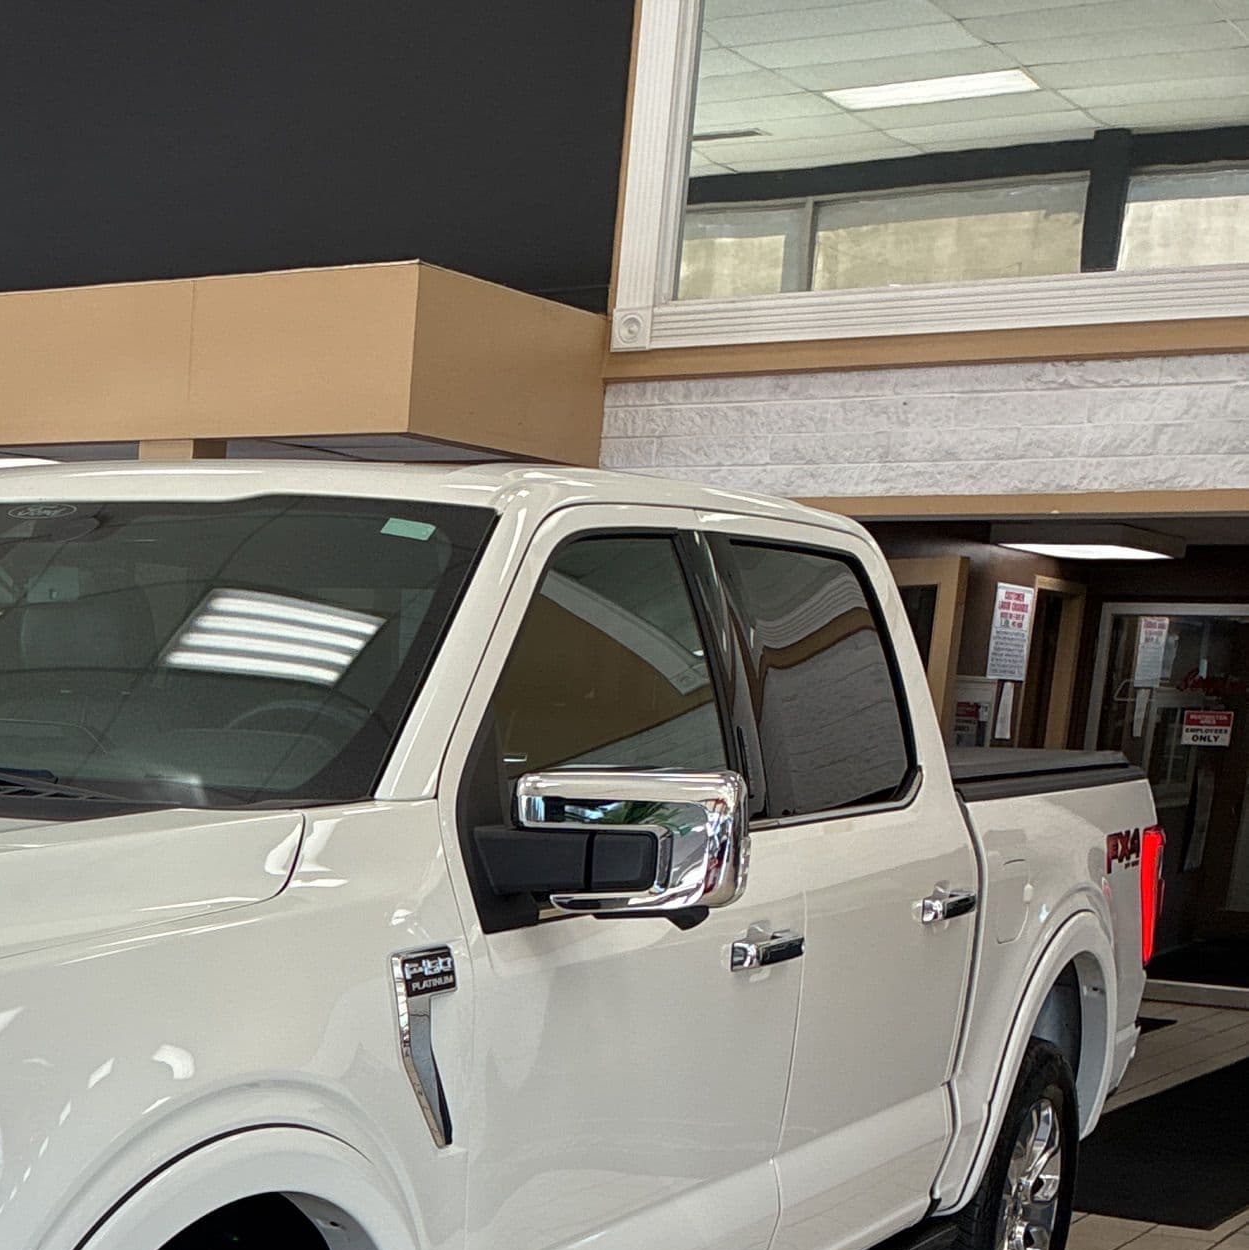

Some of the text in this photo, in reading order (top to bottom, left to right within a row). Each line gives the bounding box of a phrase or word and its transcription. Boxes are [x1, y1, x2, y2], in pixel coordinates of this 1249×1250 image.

[1191, 734, 1220, 742] ONLY
[405, 957, 452, 979] F-150
[411, 975, 454, 991] PLATINUM
